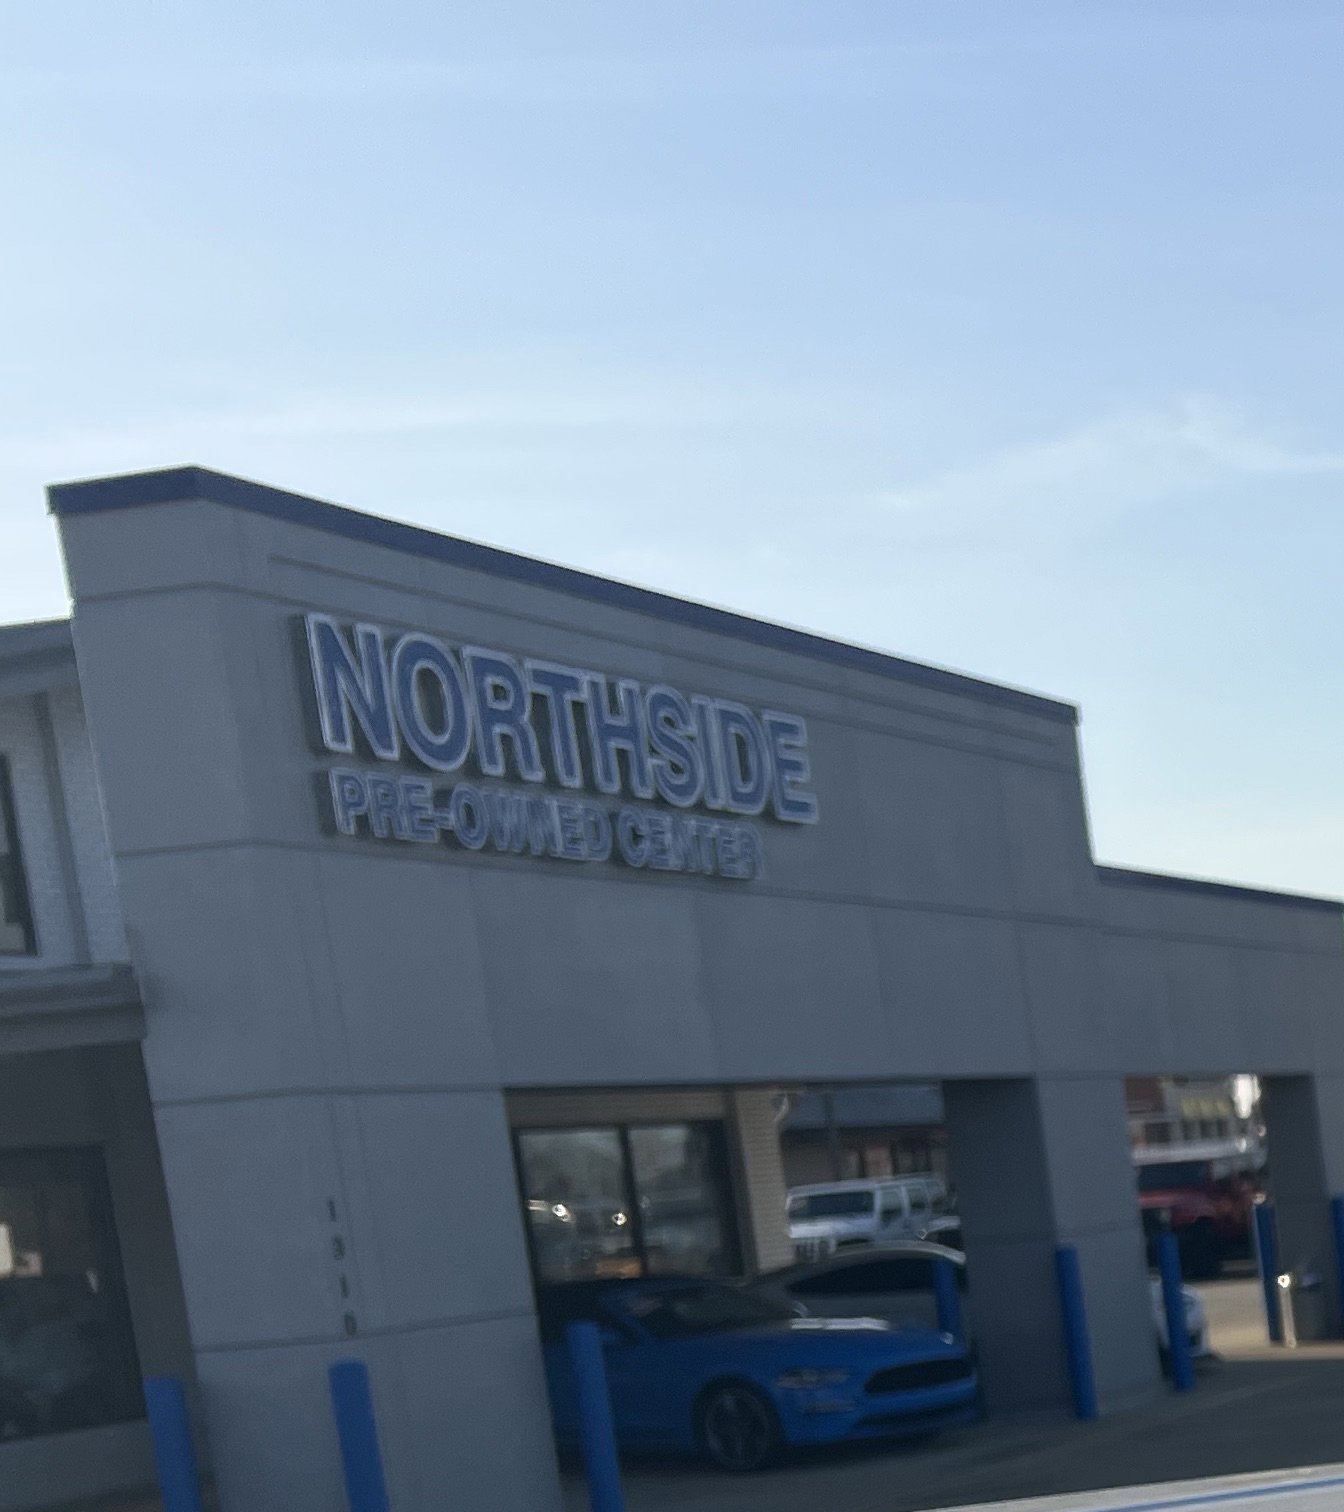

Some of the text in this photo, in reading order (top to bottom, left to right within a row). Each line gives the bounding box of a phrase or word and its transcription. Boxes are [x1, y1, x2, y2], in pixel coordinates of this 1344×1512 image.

[304, 612, 820, 824] NORTHSIDE
[328, 767, 764, 880] PRE-OWNED CENTER
